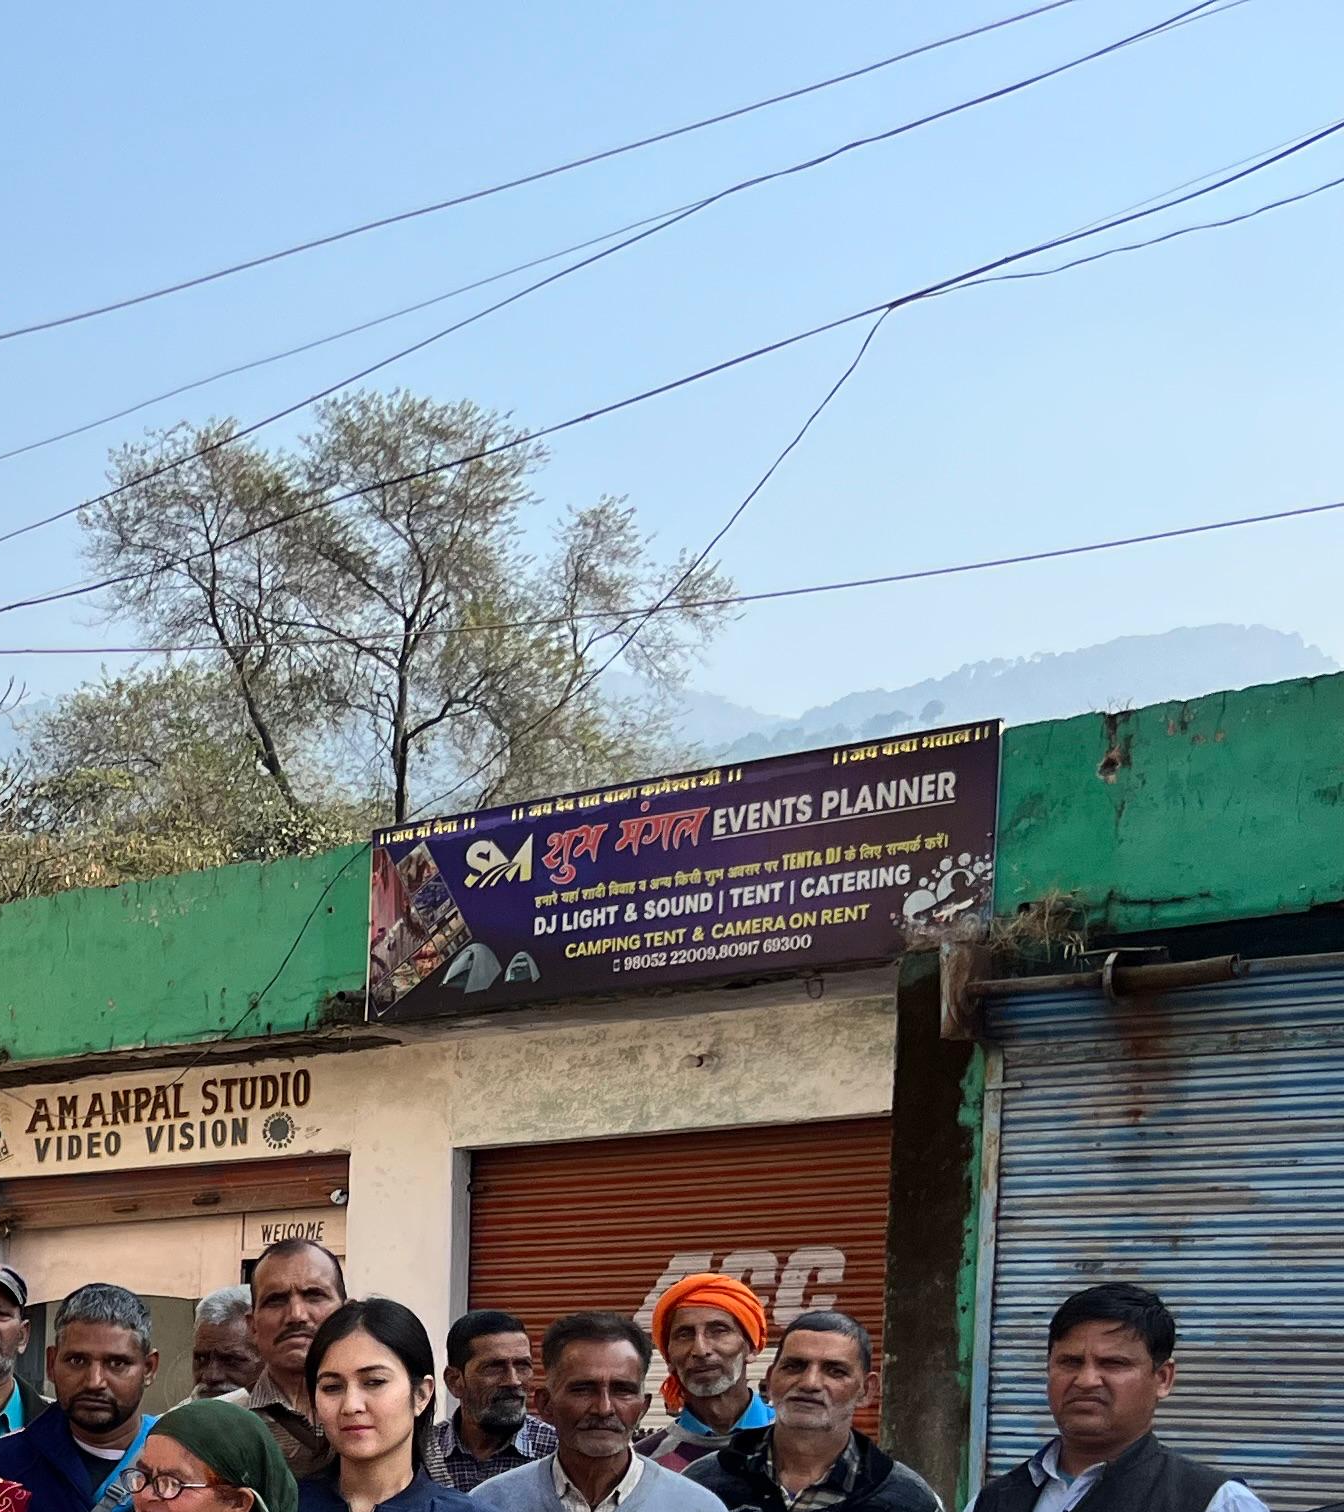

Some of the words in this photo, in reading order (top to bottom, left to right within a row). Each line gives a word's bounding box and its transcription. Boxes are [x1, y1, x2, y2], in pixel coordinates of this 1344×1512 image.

[712, 794, 813, 837] EVENTS
[821, 771, 958, 820] PLANNER
[541, 822, 608, 885] शुभ
[615, 801, 711, 856] मंगल
[534, 914, 558, 936] DJ
[561, 904, 620, 932] LIGHT
[624, 902, 638, 923] &
[643, 891, 713, 920] SOUND
[729, 881, 785, 908] TENT
[800, 863, 912, 898] CATERING
[564, 934, 641, 959] CAMPING
[644, 927, 688, 949] TENT
[691, 925, 705, 942] &
[711, 913, 786, 940] CAMERA
[789, 910, 817, 930] ON
[820, 903, 872, 926] RENT
[623, 952, 667, 971] 98052
[762, 933, 812, 954] 69300
[24, 1083, 190, 1134] AMANPAL
[201, 1068, 312, 1116] STUDIO
[34, 1130, 122, 1163] VIDEO
[145, 1116, 250, 1153] VISION
[260, 1220, 326, 1244] WELCOME
